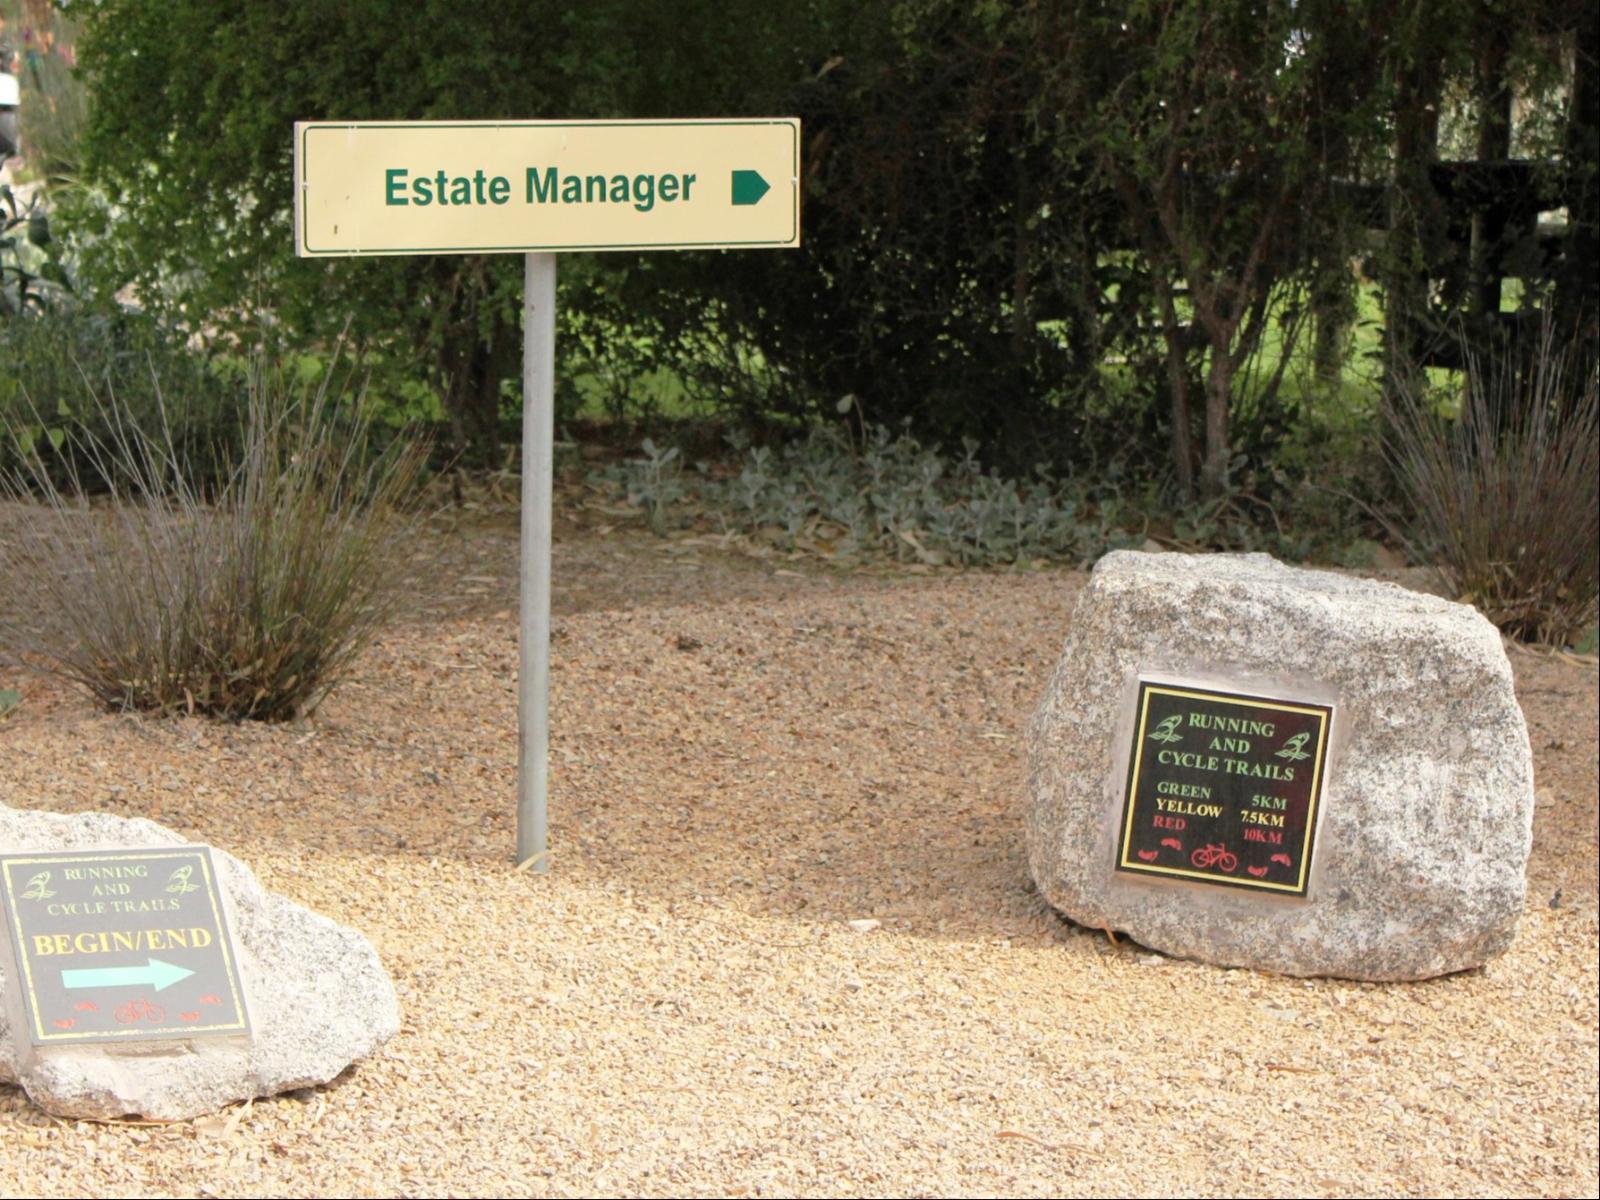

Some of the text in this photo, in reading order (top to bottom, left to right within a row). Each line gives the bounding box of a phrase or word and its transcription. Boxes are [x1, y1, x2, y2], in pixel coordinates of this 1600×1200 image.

[385, 167, 697, 212] Estate Manager
[1189, 713, 1275, 737] RUNNING
[1209, 737, 1250, 754] AND
[1158, 751, 1295, 781] CYCLE TRAILS
[1156, 798, 1223, 818] YELLOW
[1157, 781, 1287, 811] GREEN 5KM
[1153, 815, 1283, 845] RED 10KM
[64, 865, 148, 880] RUNNING
[91, 883, 131, 896] AND
[47, 898, 181, 917] CYCLE TRAILS
[32, 927, 212, 956] BEGIN/END
